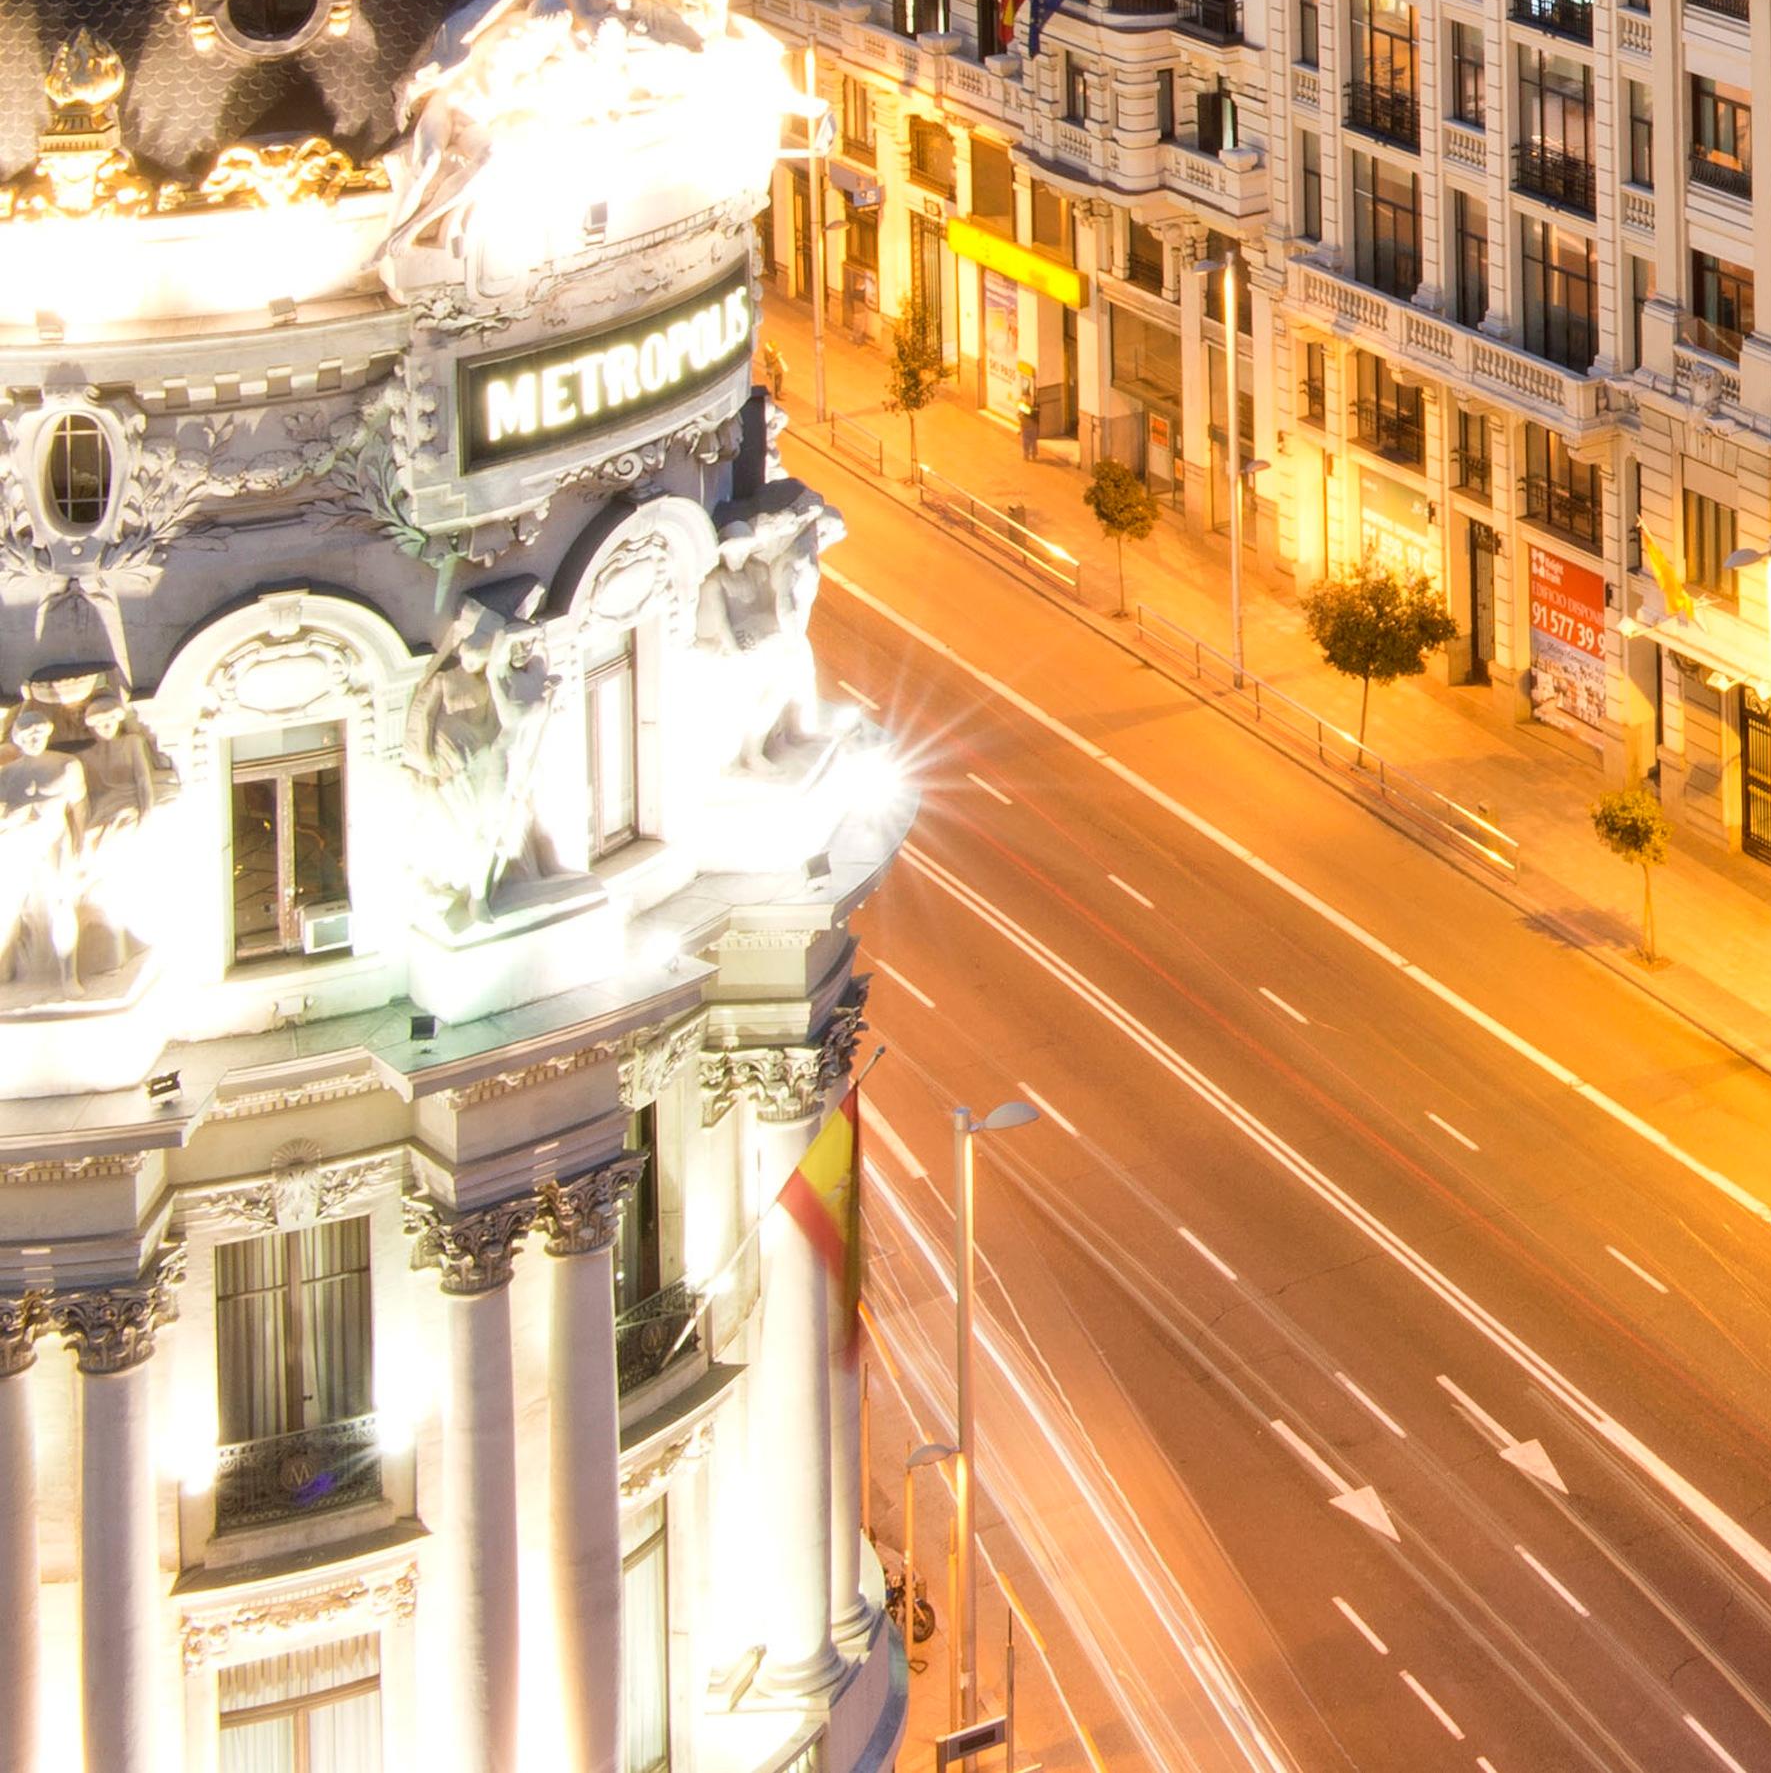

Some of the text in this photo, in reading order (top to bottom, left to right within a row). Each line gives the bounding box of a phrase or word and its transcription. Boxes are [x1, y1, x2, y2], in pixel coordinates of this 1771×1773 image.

[486, 285, 749, 442] METROPOLIS
[1532, 601, 1547, 628] 91
[1550, 609, 1575, 641] 577
[1577, 623, 1595, 651] 39
